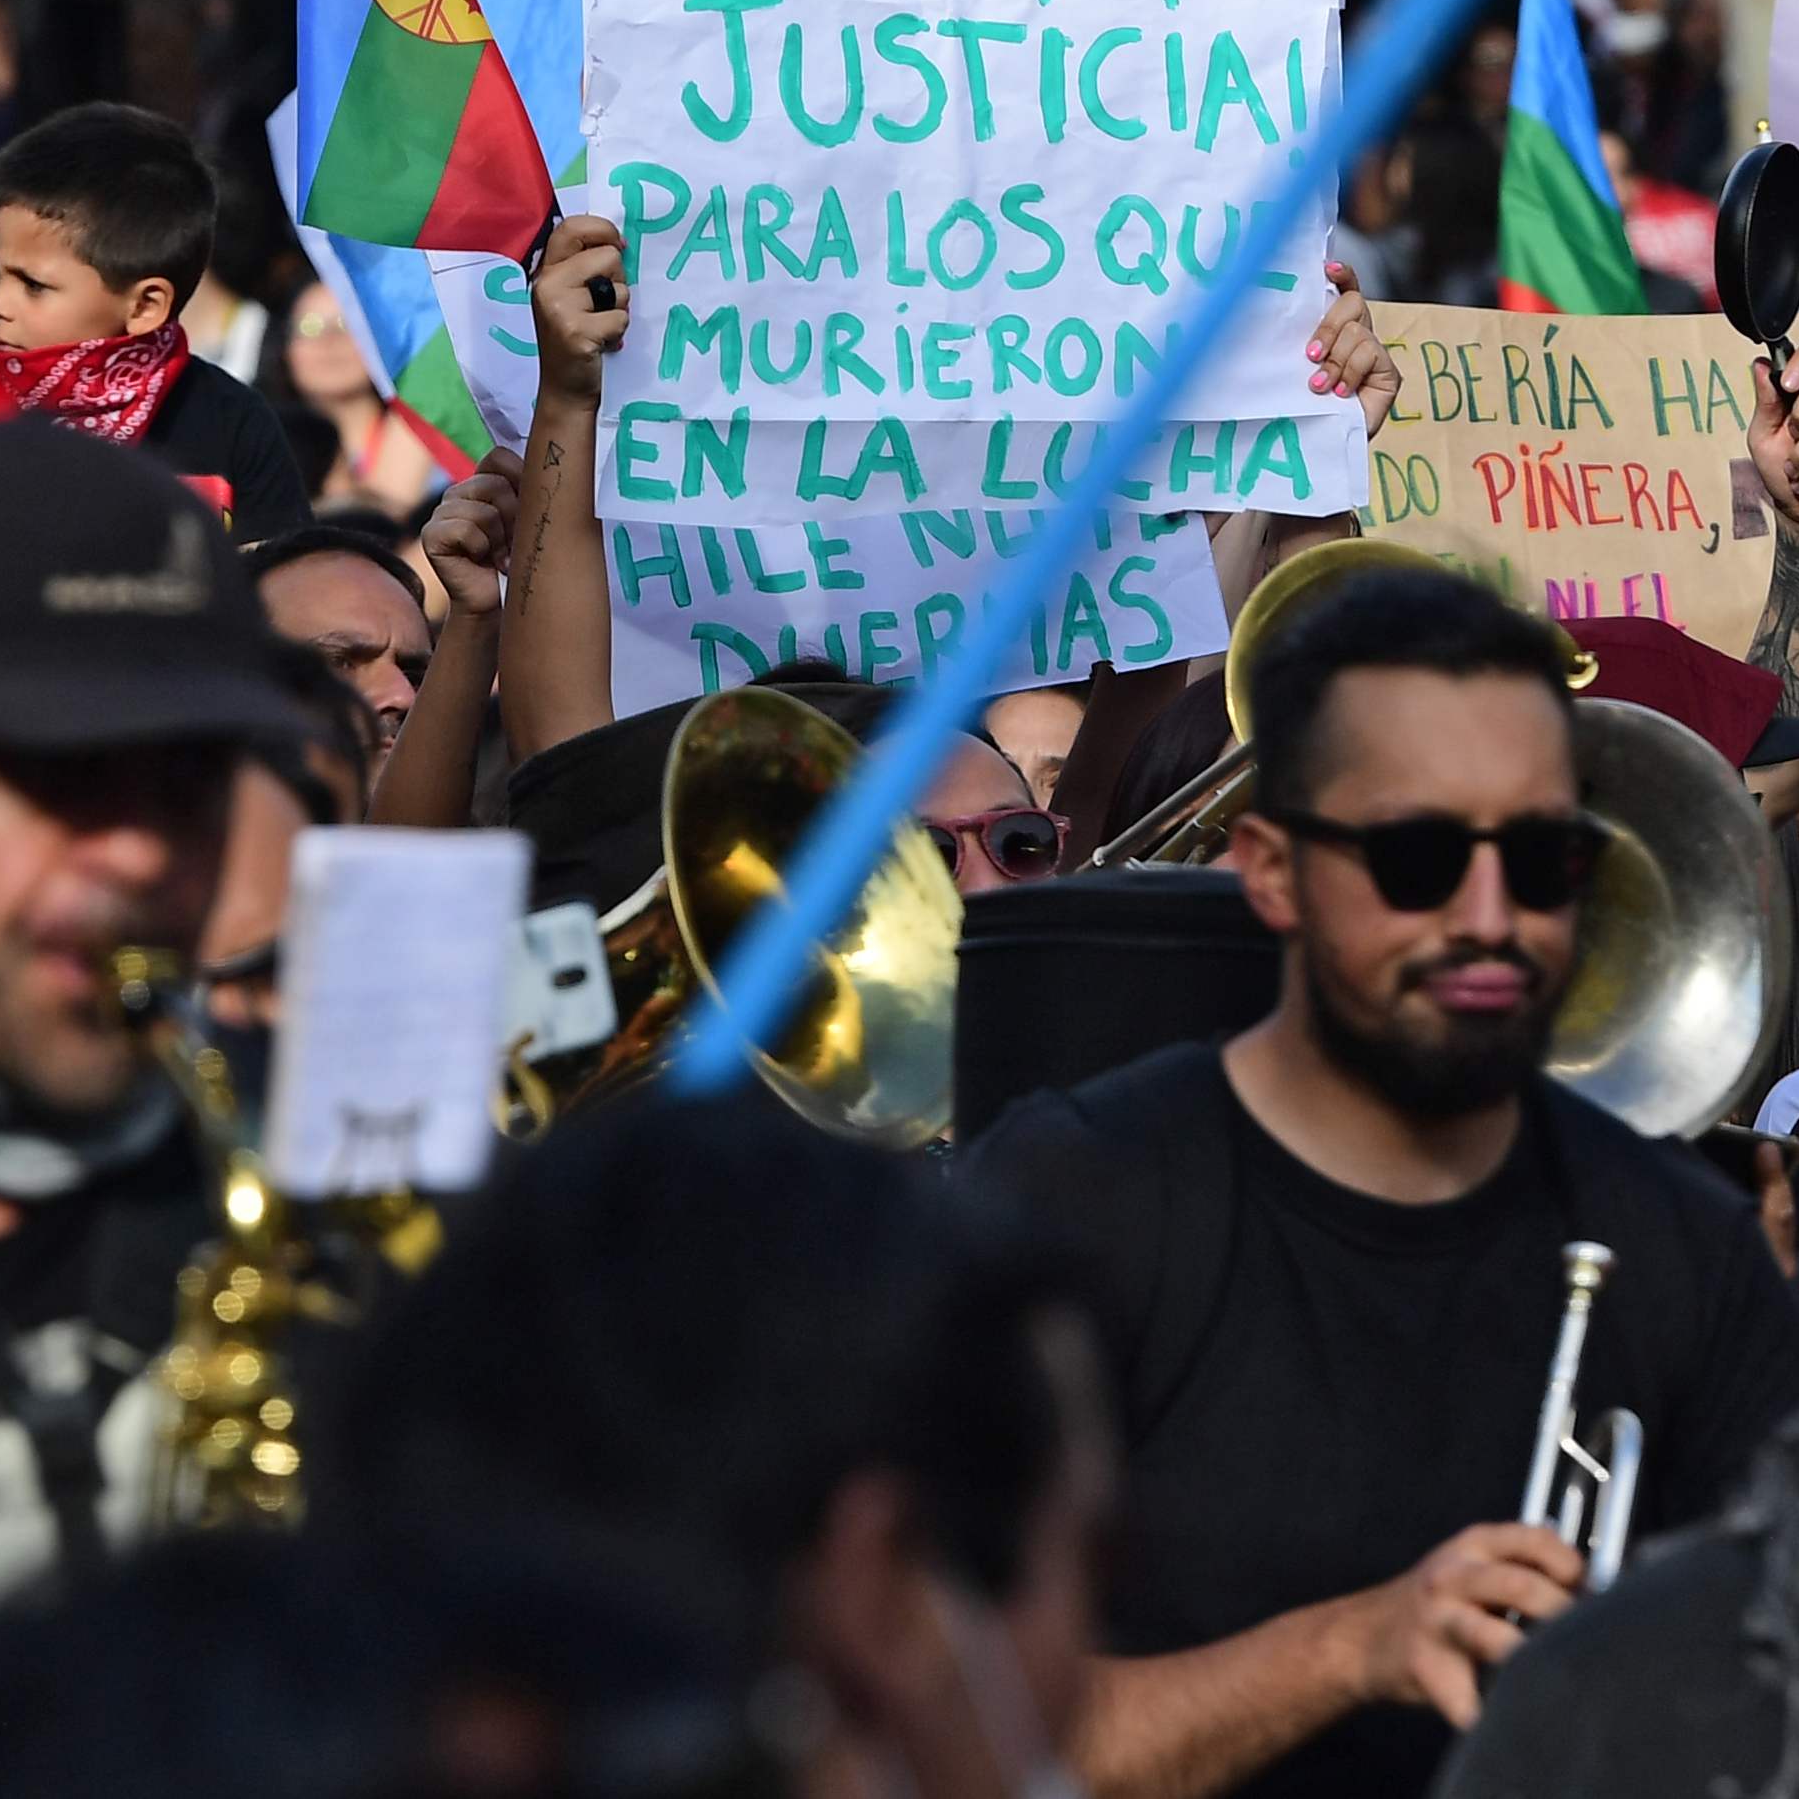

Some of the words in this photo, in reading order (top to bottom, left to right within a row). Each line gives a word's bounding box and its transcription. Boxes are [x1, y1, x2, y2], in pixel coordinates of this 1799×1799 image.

[609, 162, 859, 286] PARA
[885, 183, 1065, 291] LOS
[616, 401, 751, 502] EN
[796, 414, 928, 502] LA
[1358, 449, 1441, 527] DO
